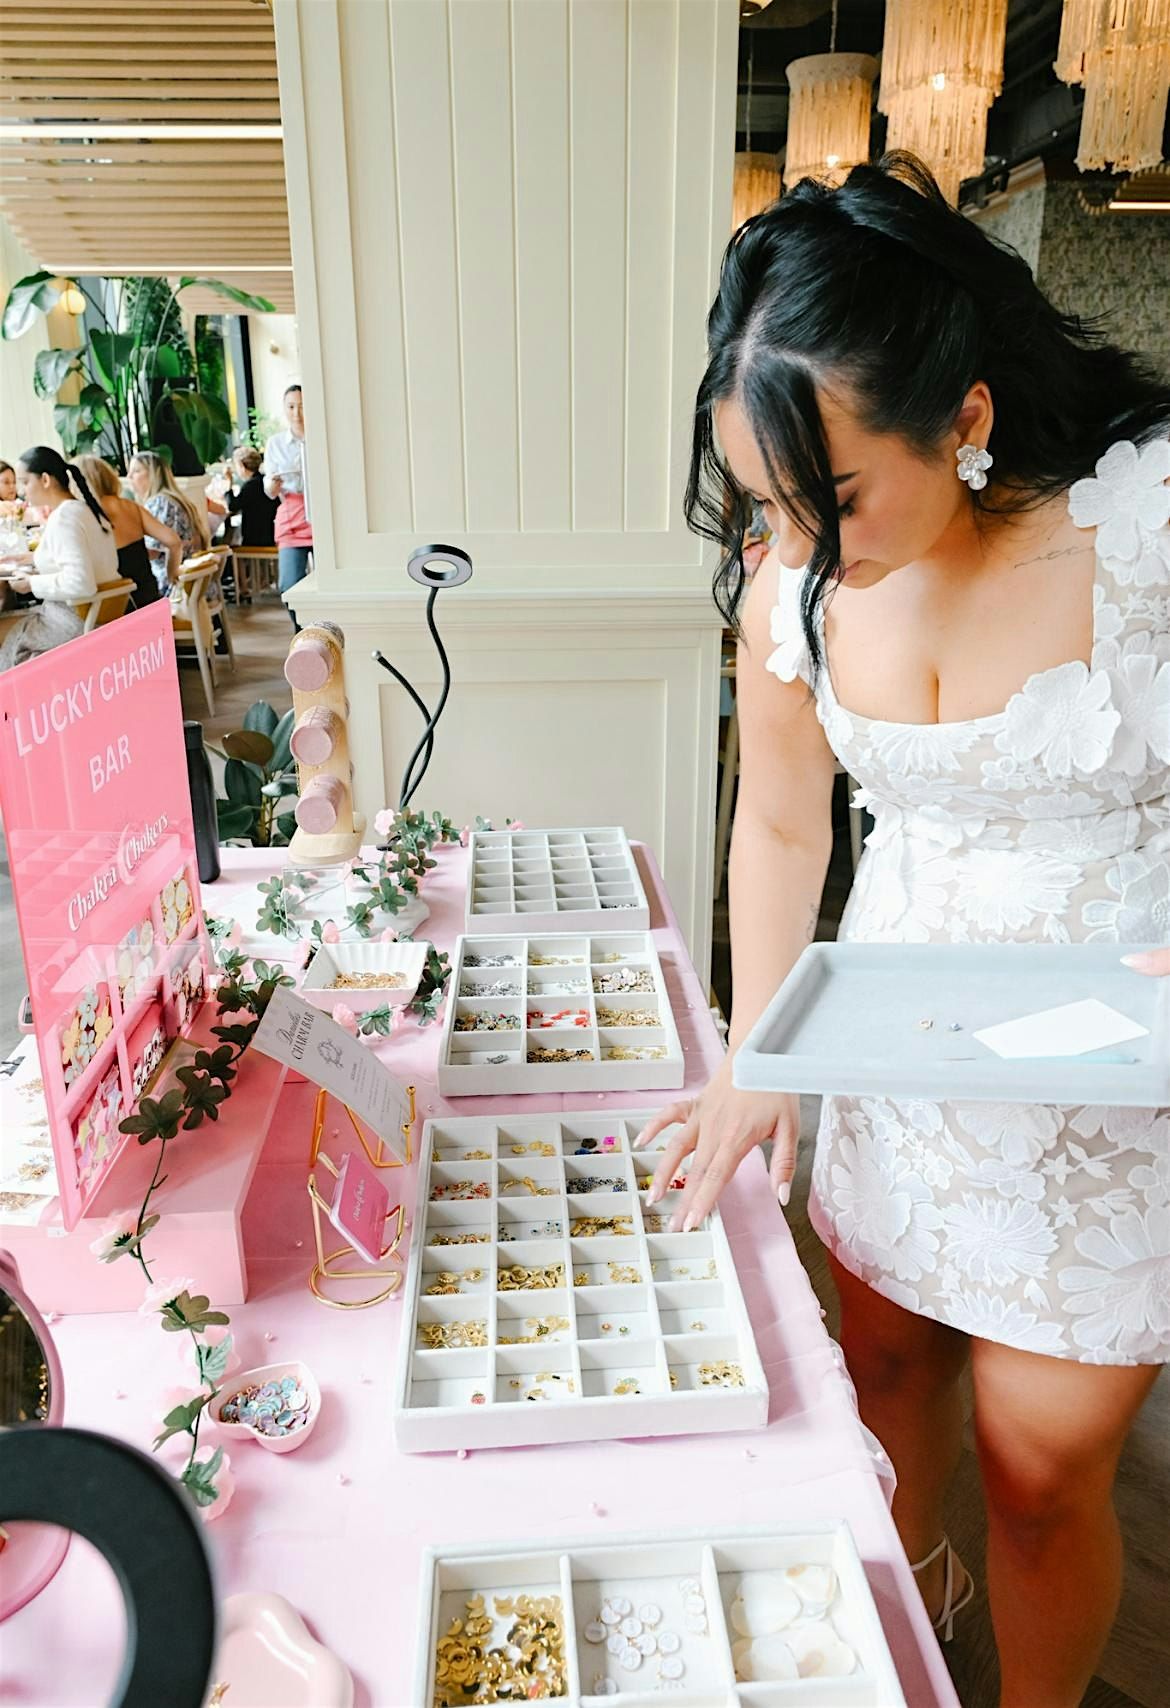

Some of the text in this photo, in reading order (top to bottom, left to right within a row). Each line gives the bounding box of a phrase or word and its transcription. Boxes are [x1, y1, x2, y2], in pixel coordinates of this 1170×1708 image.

[14, 637, 165, 757] LUCKY CHARM
[88, 734, 132, 793] BAR
[68, 814, 169, 932] Chakra Chokers
[291, 1011, 315, 1060] CHARM BAR
